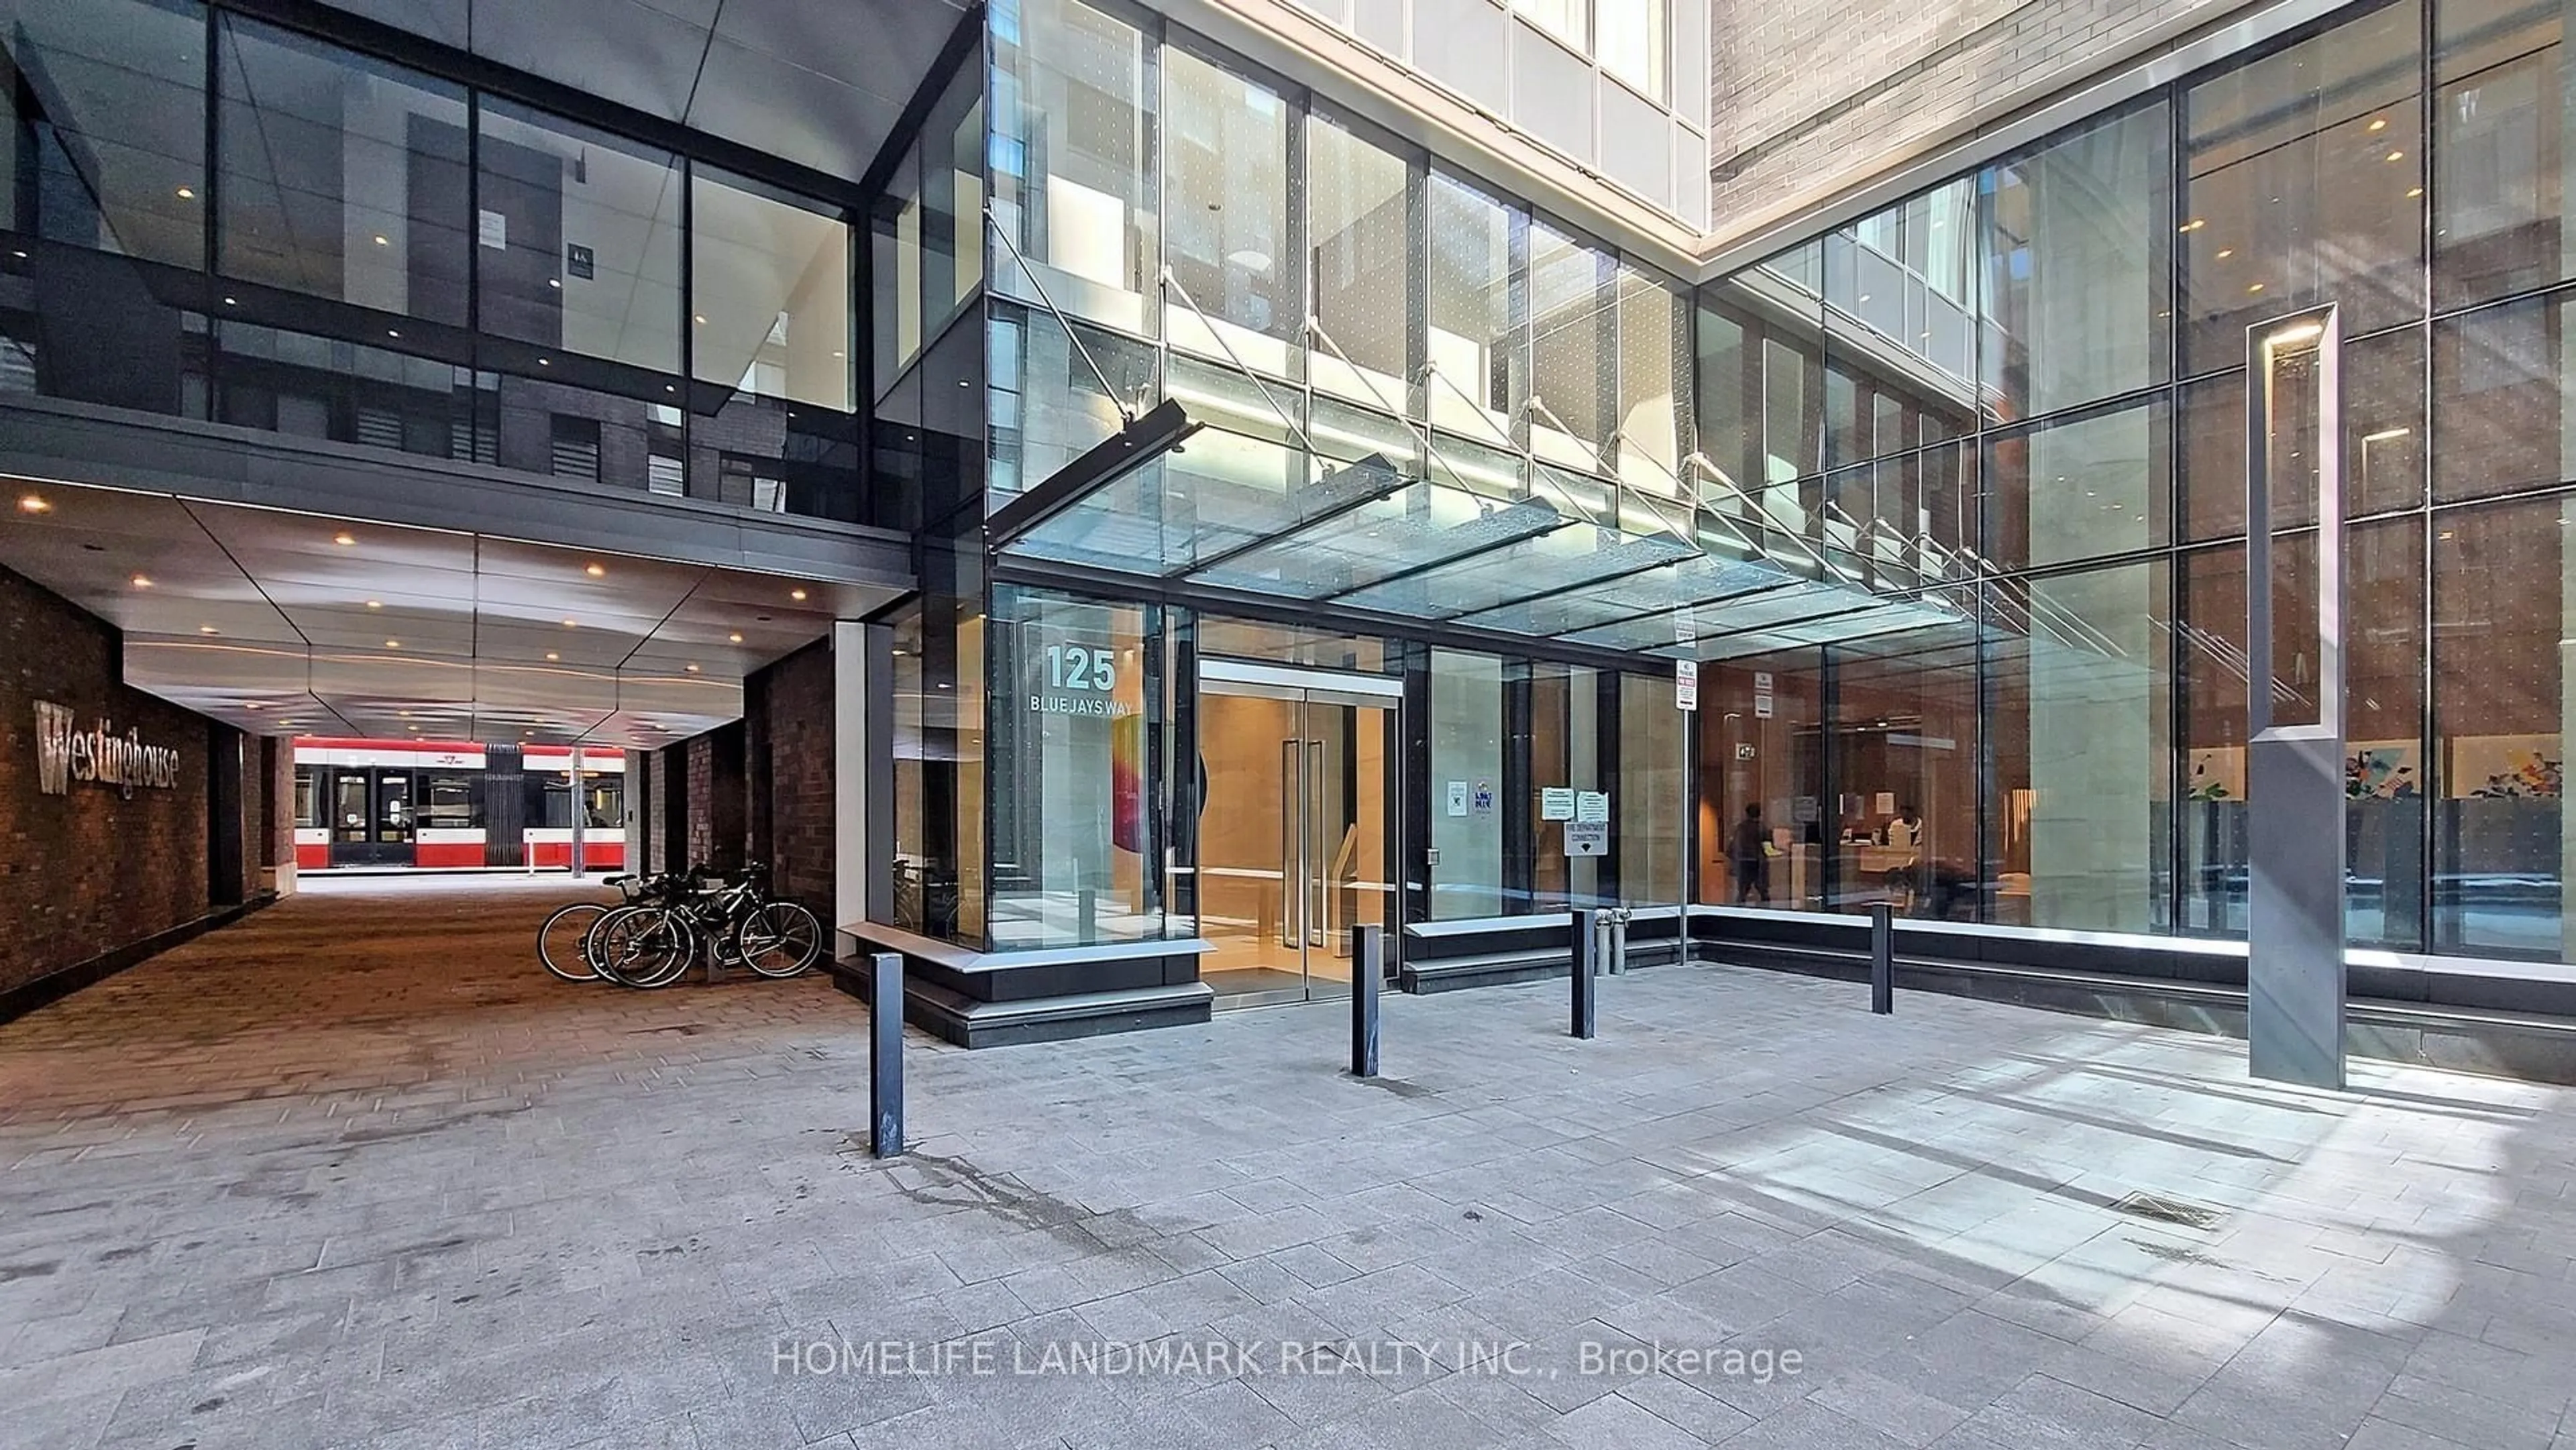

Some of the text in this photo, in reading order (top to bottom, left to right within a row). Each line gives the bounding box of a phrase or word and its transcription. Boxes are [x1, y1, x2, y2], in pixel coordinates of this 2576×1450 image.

[1047, 646, 1116, 691] 125
[1030, 695, 1132, 716] BLUE JAYS WAY
[34, 699, 179, 800] Westinghouse
